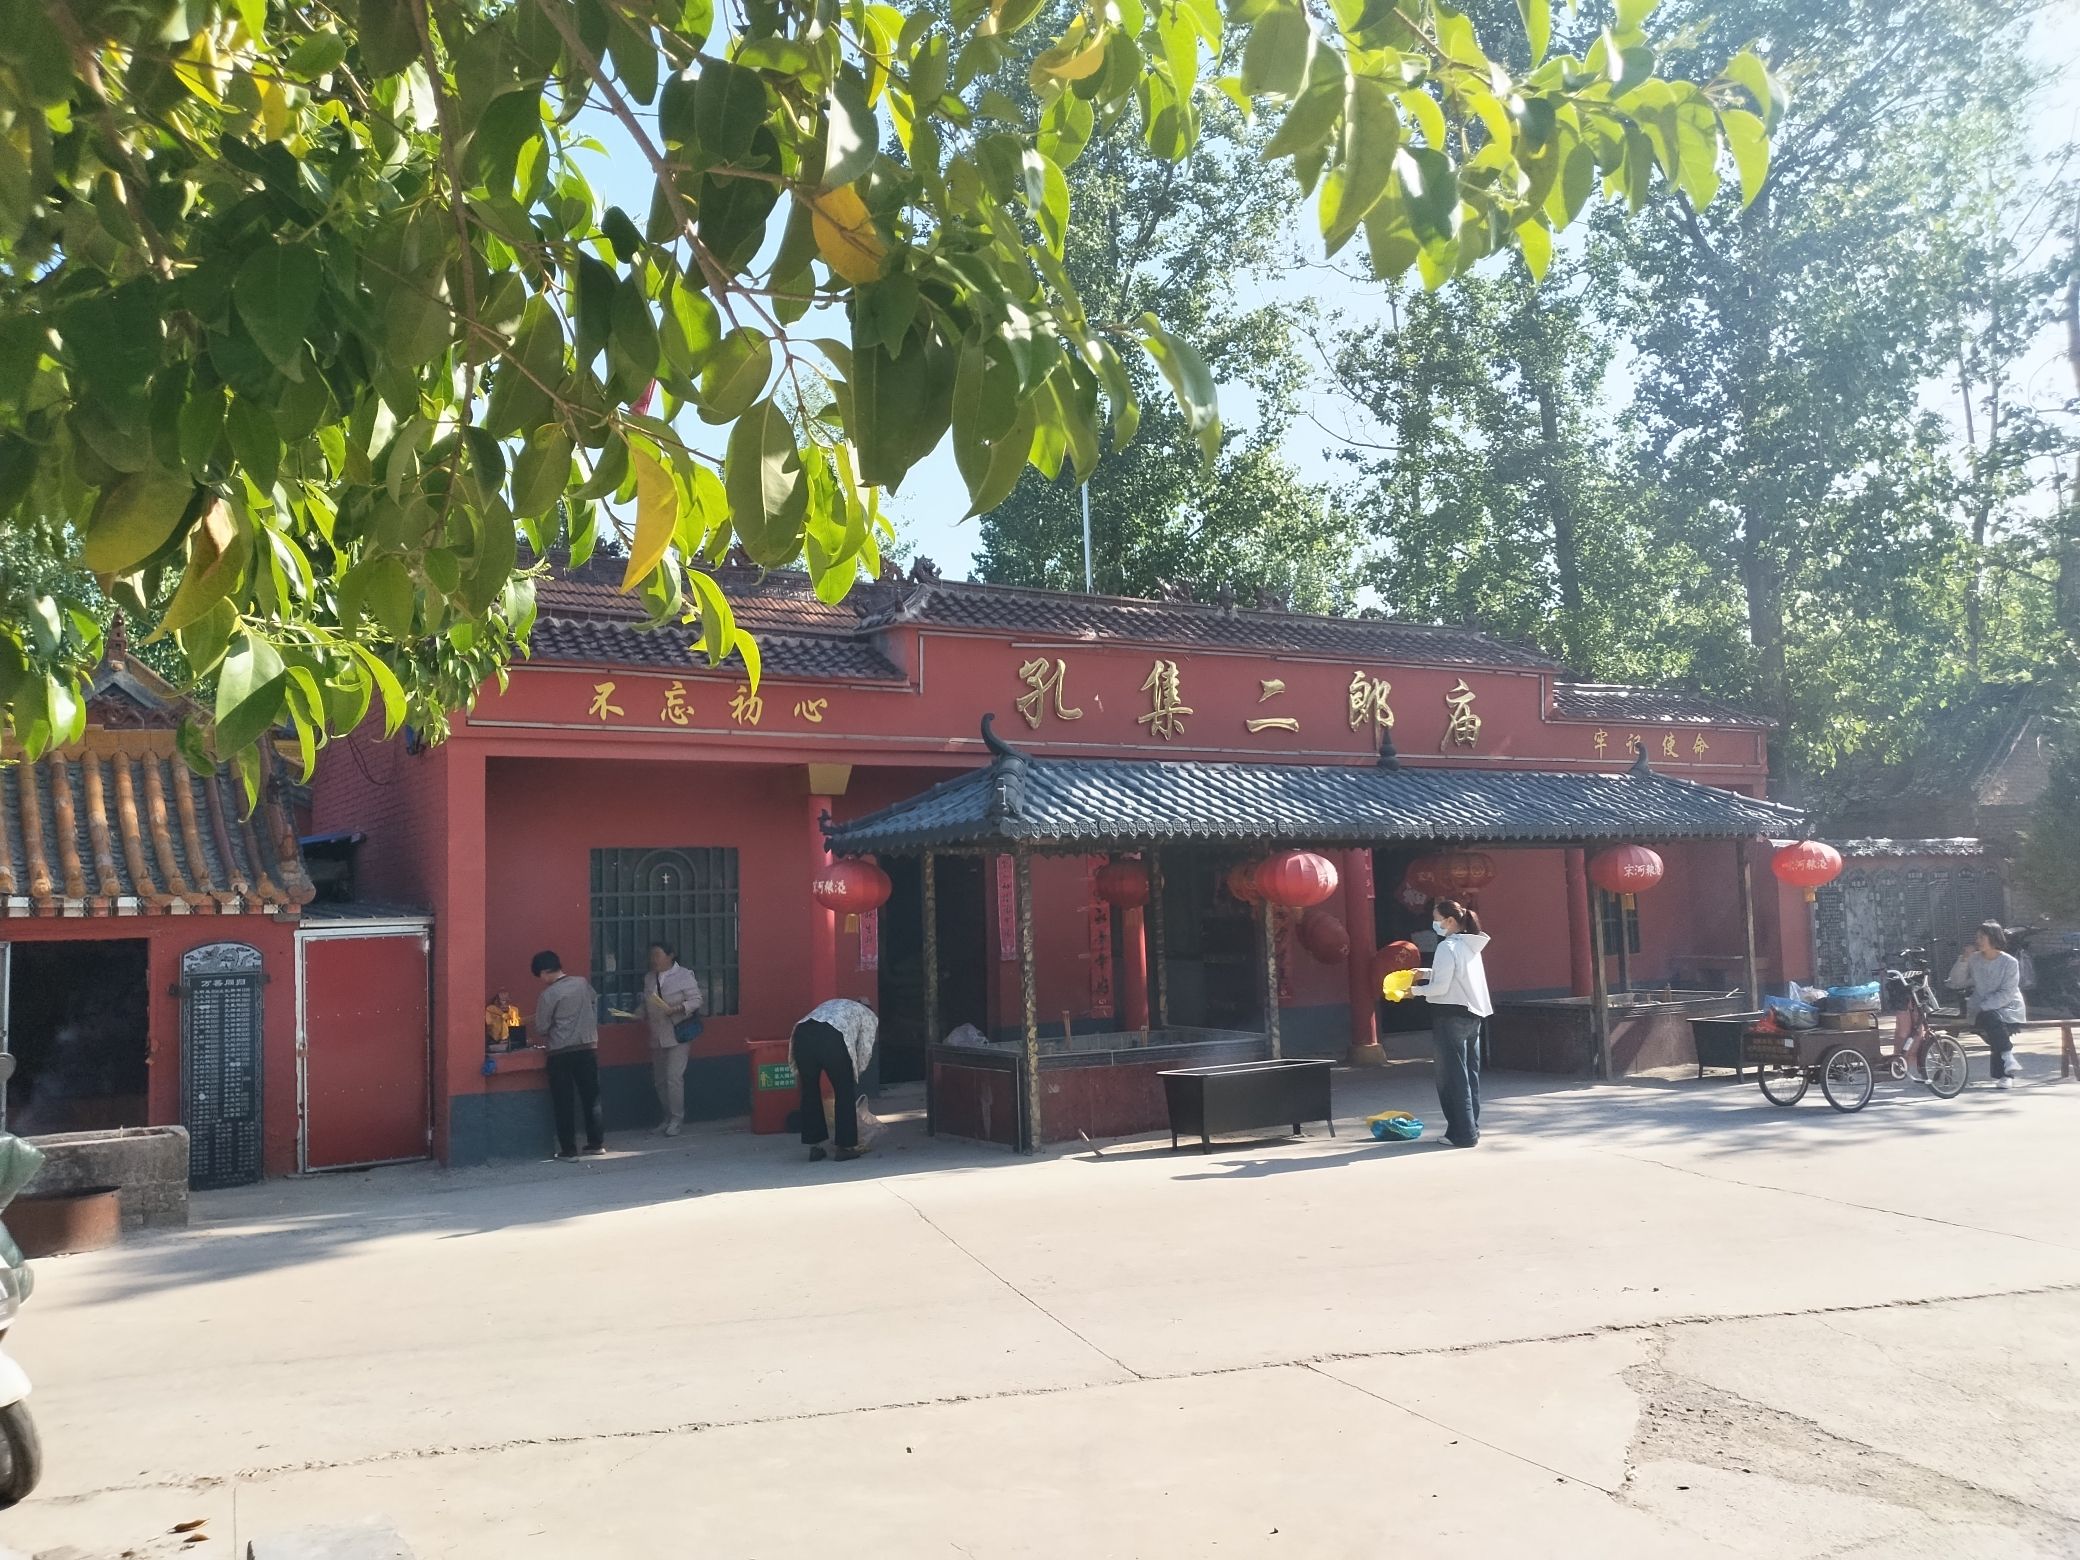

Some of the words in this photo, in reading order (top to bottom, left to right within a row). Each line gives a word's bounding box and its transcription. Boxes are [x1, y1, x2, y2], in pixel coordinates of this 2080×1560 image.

[588, 680, 828, 726] 不忘初心
[1016, 657, 1482, 752] 孔集二郎庙
[1593, 728, 1710, 760] 牢记使命
